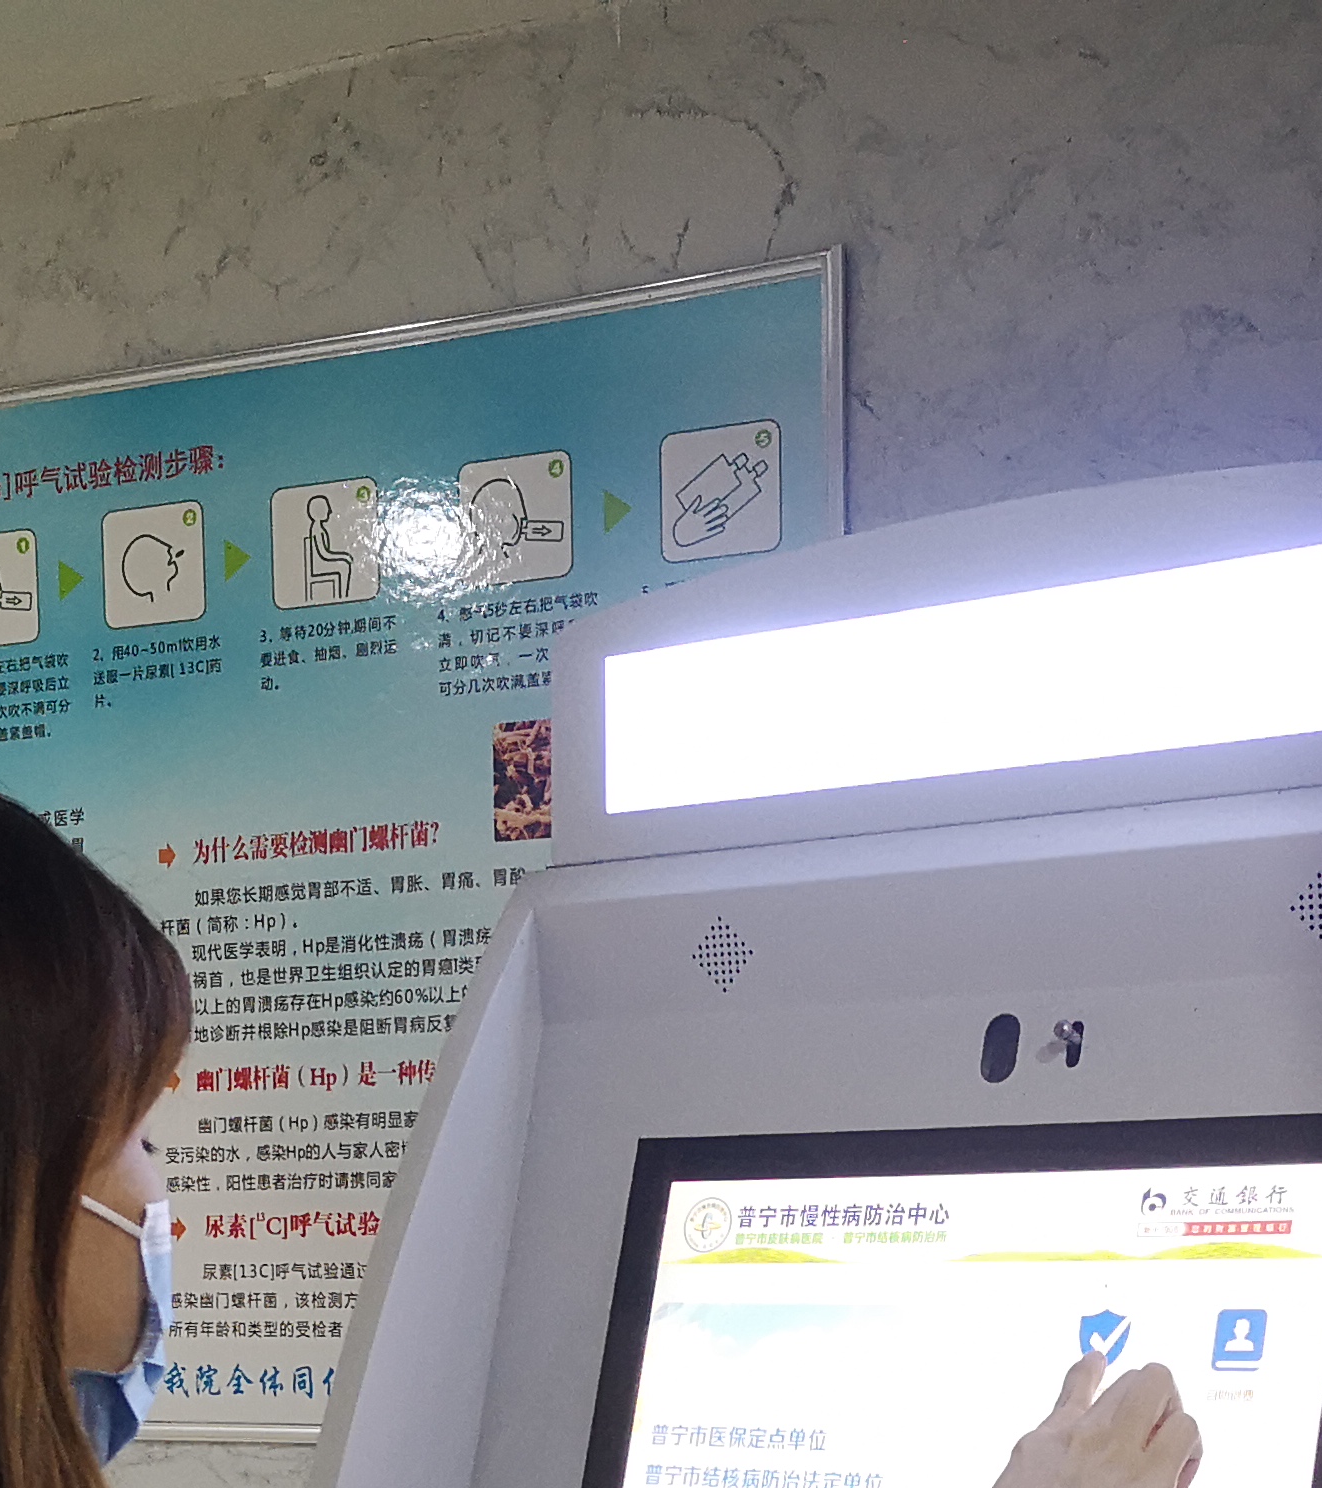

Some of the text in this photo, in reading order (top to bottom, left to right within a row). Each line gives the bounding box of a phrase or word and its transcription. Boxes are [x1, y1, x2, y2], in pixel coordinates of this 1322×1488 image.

[737, 1202, 950, 1228] 普宁市慢性病防治中心
[168, 1321, 343, 1339] 所有年龄和类型的受检者
[651, 1424, 827, 1451] 普宁市医保定点单位
